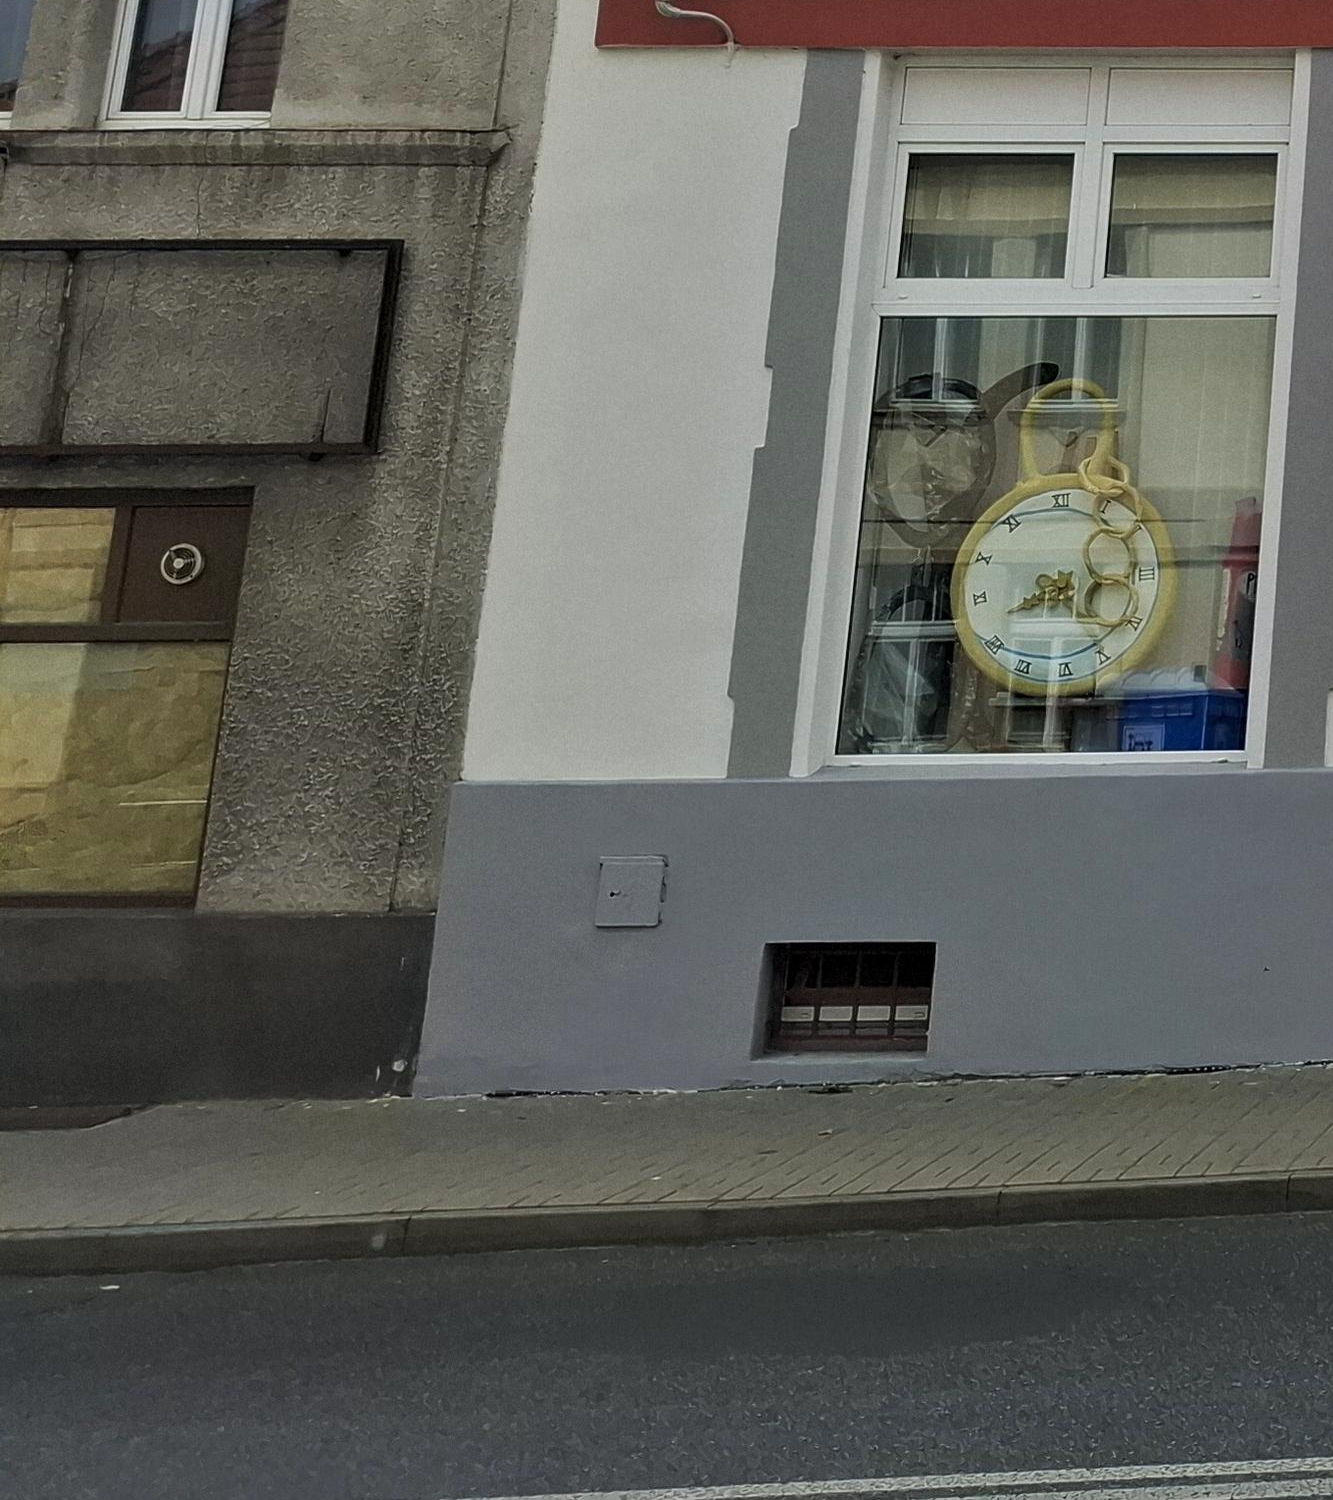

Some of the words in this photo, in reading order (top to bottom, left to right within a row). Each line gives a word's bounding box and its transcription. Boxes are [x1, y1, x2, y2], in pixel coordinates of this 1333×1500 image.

[1051, 493, 1071, 508] XII
[1001, 514, 1021, 533] XI
[975, 552, 993, 566] X
[1138, 567, 1155, 581] III
